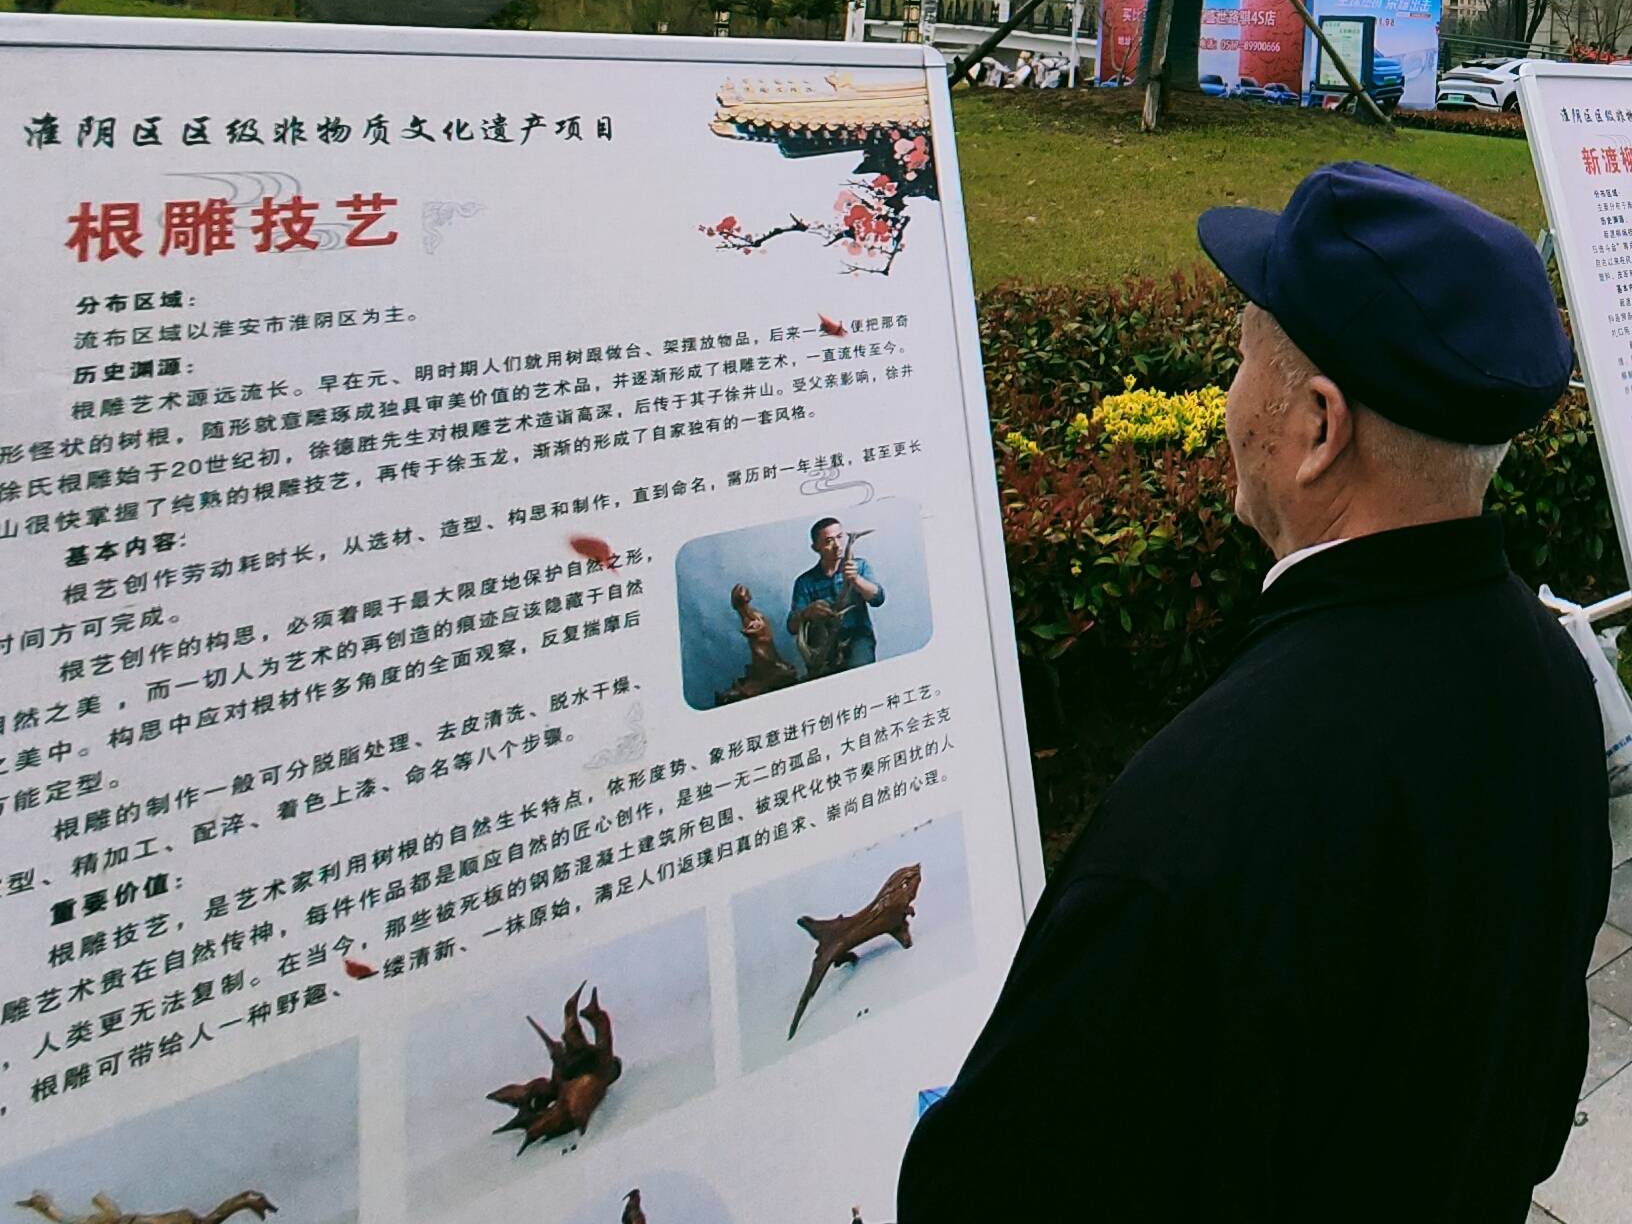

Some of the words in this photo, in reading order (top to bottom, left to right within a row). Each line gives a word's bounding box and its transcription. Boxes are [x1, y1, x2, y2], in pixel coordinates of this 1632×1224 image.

[25, 111, 615, 149] 淮阴区区级非物质文化遗产项目
[64, 192, 400, 263] 根雕技艺
[75, 290, 196, 315] 分布区域：
[73, 306, 418, 350] 流布区域以淮安市淮阴区为主。
[73, 358, 195, 386] 历史渊源：
[64, 532, 187, 567] 基本内容：
[0, 581, 645, 735] 然之美，而一切人为艺术的再创造的痕迹应该隐藏于自然
[0, 727, 575, 895] 型、精加工、配淬、着色上漆、命名等八个步骤。
